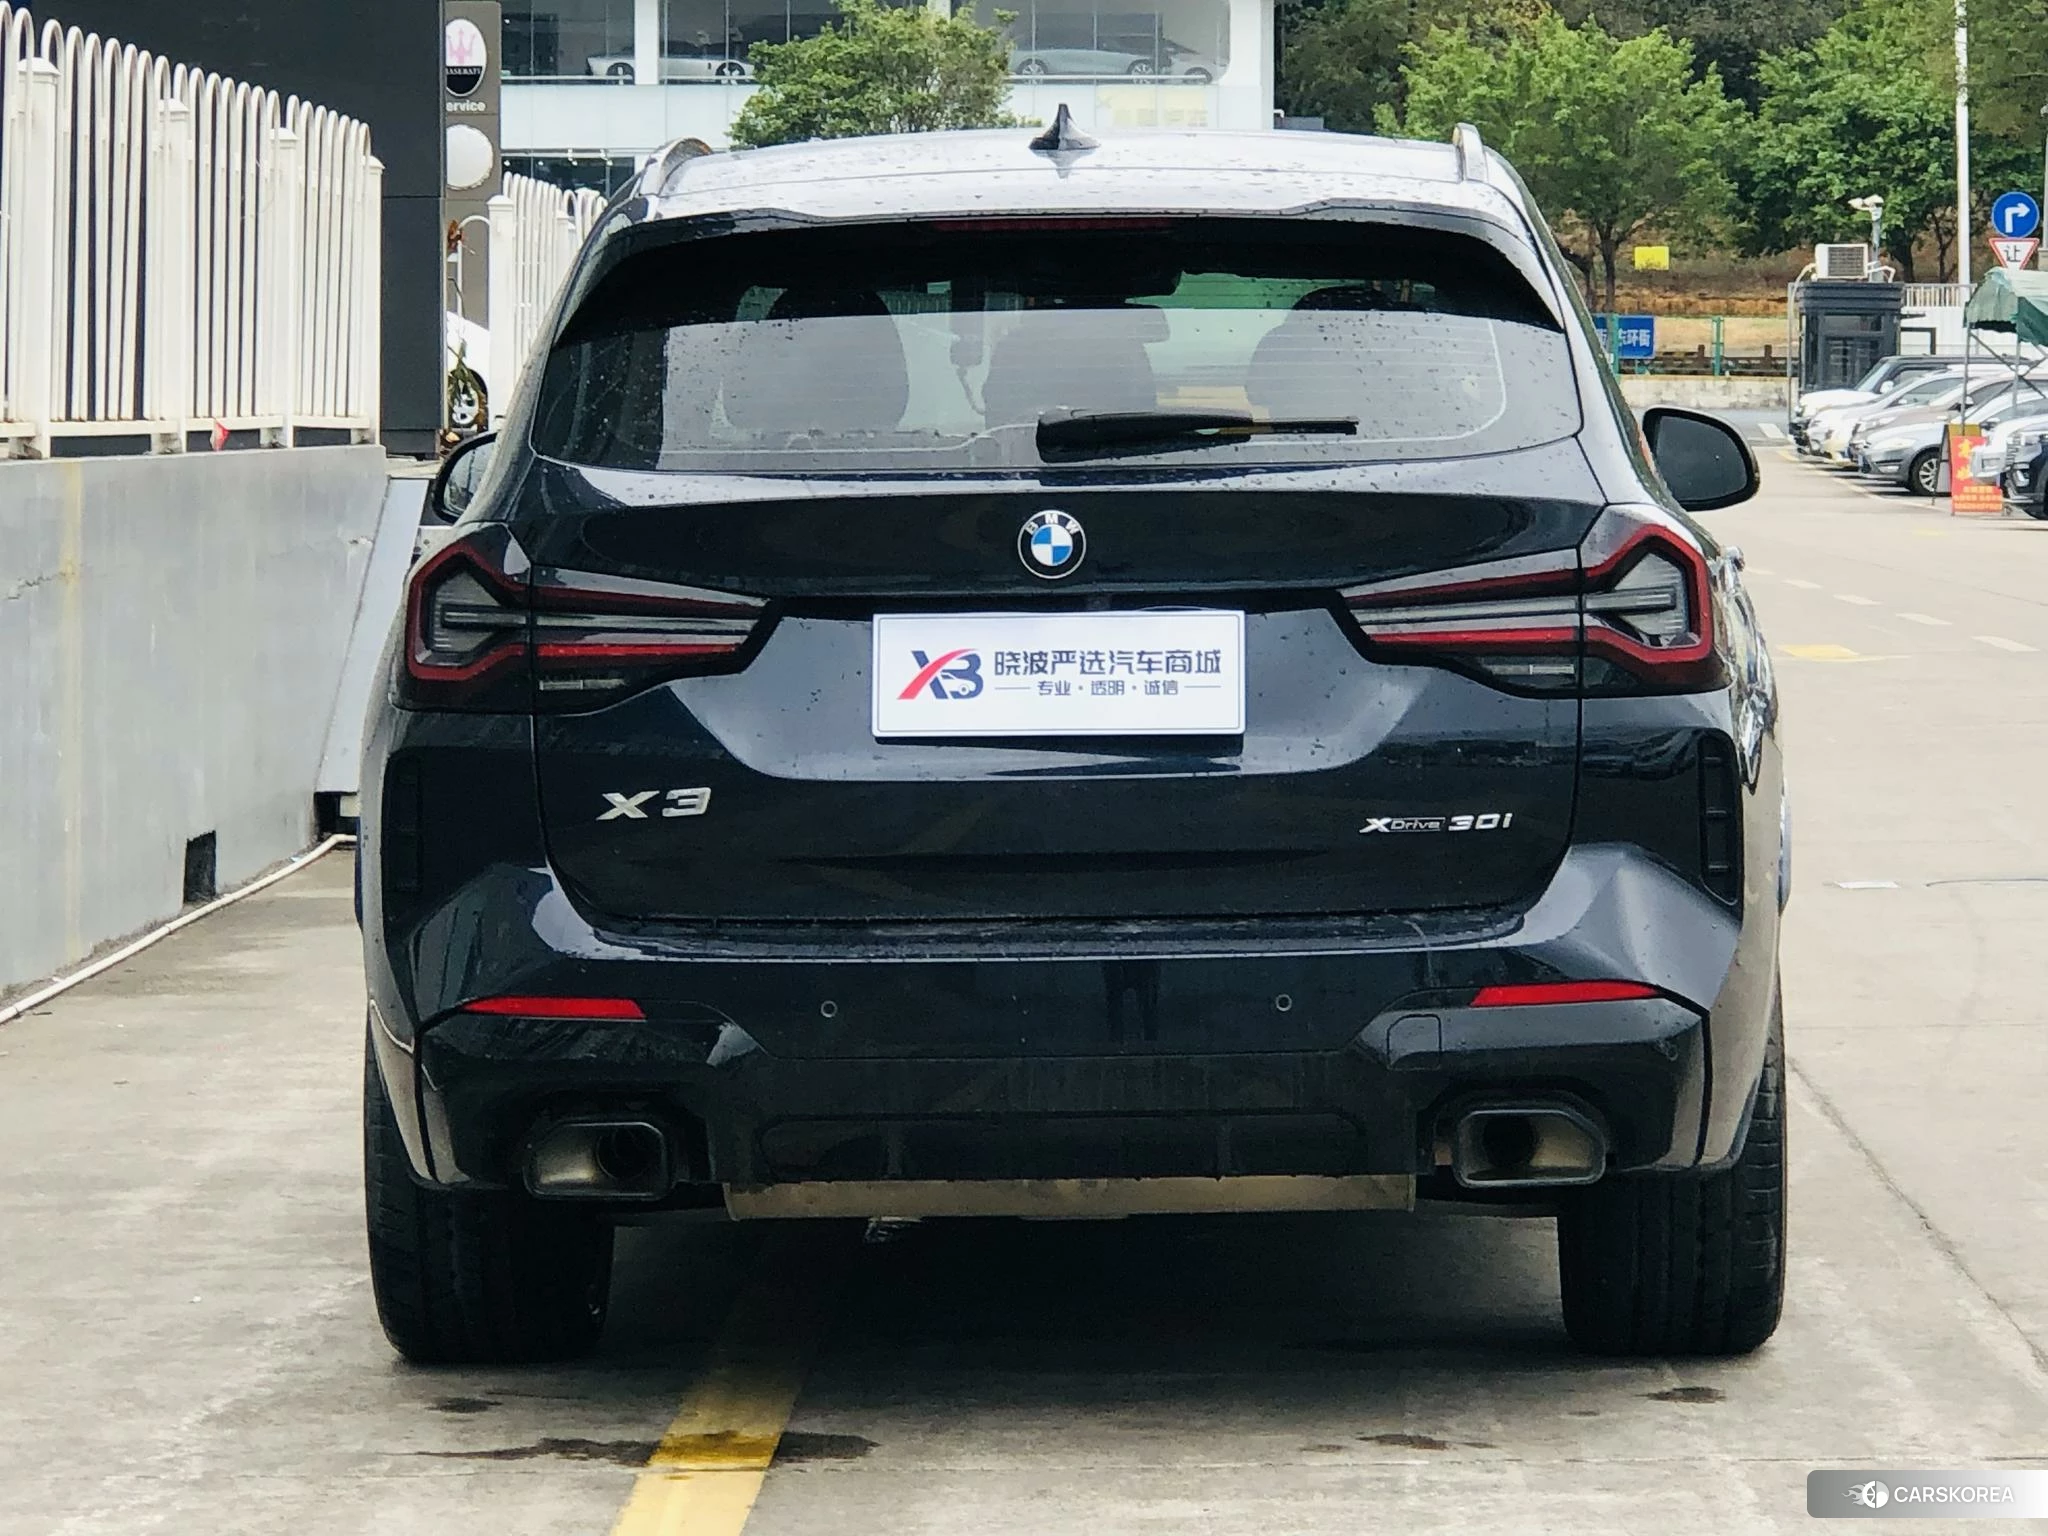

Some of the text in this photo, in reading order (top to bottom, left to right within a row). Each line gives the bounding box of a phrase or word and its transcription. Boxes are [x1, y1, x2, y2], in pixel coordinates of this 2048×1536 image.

[446, 99, 486, 112] ervice
[2003, 244, 2021, 262] 让
[1024, 512, 1081, 535] BMW
[993, 650, 1221, 676] 晓波严选汽车商城
[596, 787, 711, 821] X3
[1448, 812, 1513, 832] 30i
